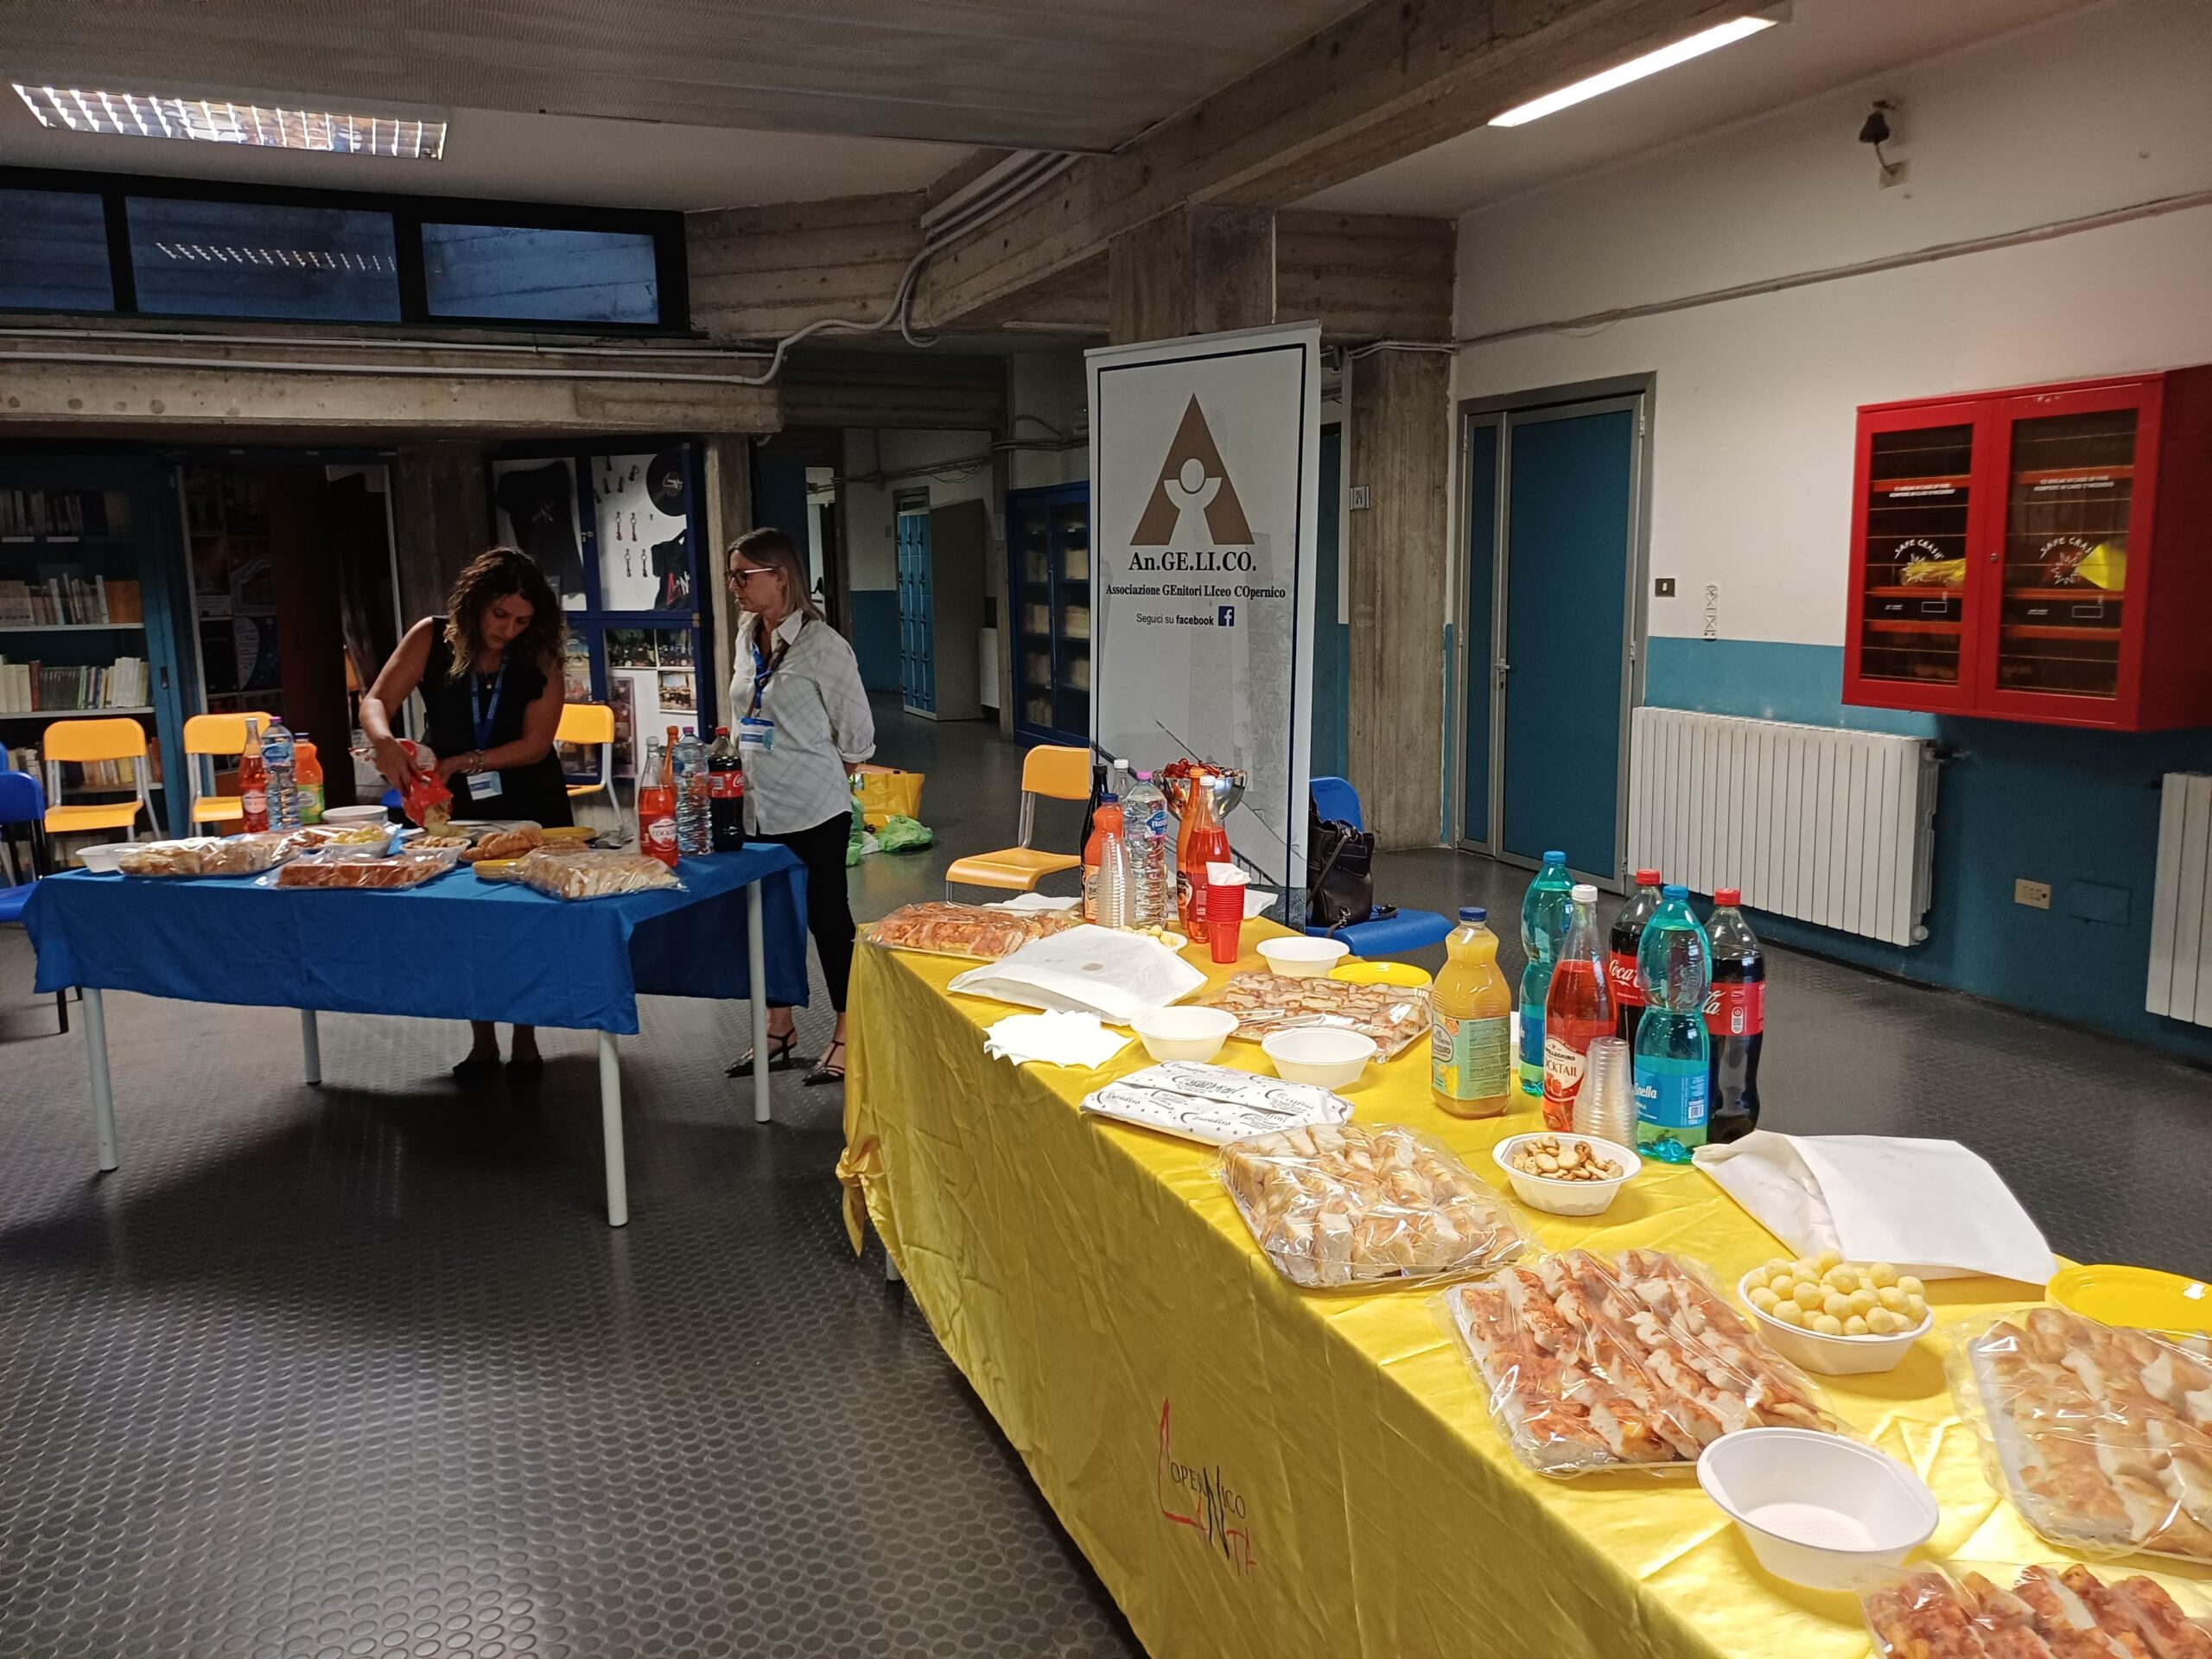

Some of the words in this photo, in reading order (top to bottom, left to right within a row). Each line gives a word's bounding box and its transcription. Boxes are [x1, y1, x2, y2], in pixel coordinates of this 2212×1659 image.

[1894, 538, 1916, 560] SAFE
[1917, 538, 1943, 560] CRASH
[2039, 537, 2066, 560] SAFE
[2069, 537, 2094, 555] CRAS
[1128, 551, 1256, 571] An.GE.LI.CO.
[1106, 583, 1160, 596] Associazione
[1162, 584, 1202, 596] GEnitori
[1204, 585, 1231, 597] LIceo
[1234, 585, 1286, 601] COpernico
[1136, 613, 1163, 626] Seguici
[1165, 615, 1174, 624] su
[1176, 614, 1214, 626] facebook
